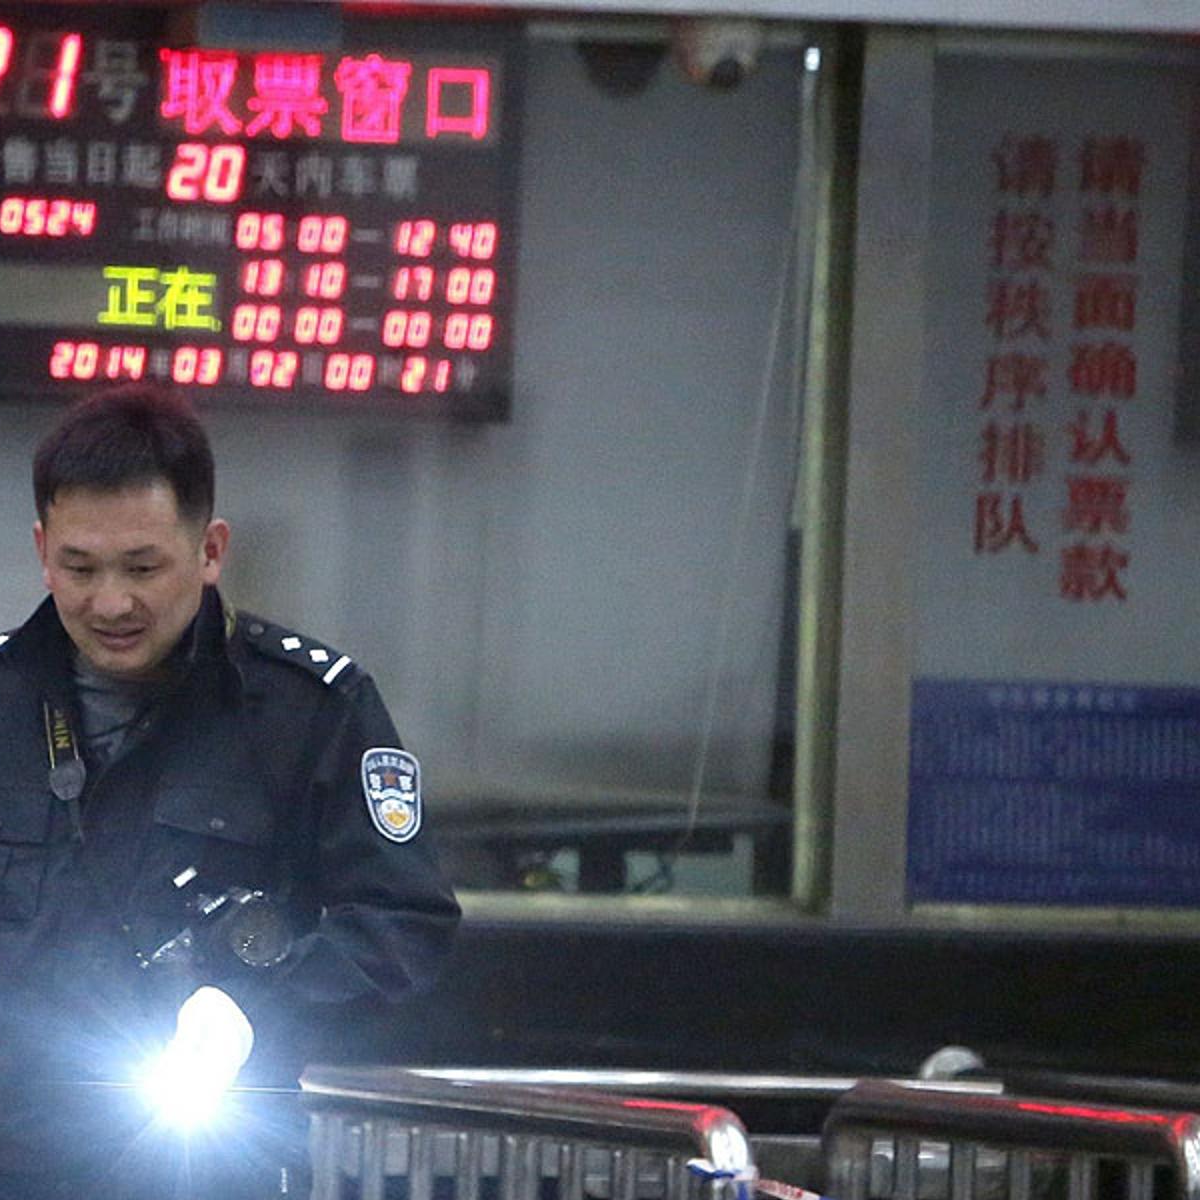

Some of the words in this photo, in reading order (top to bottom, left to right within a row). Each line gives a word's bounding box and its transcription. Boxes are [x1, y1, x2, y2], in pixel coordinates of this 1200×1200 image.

[87, 40, 146, 122] 号
[161, 49, 490, 143] 取票窗口
[167, 143, 246, 202] 20
[252, 152, 418, 198] 天内车票
[0, 197, 96, 236] 0524
[98, 265, 216, 331] 正在
